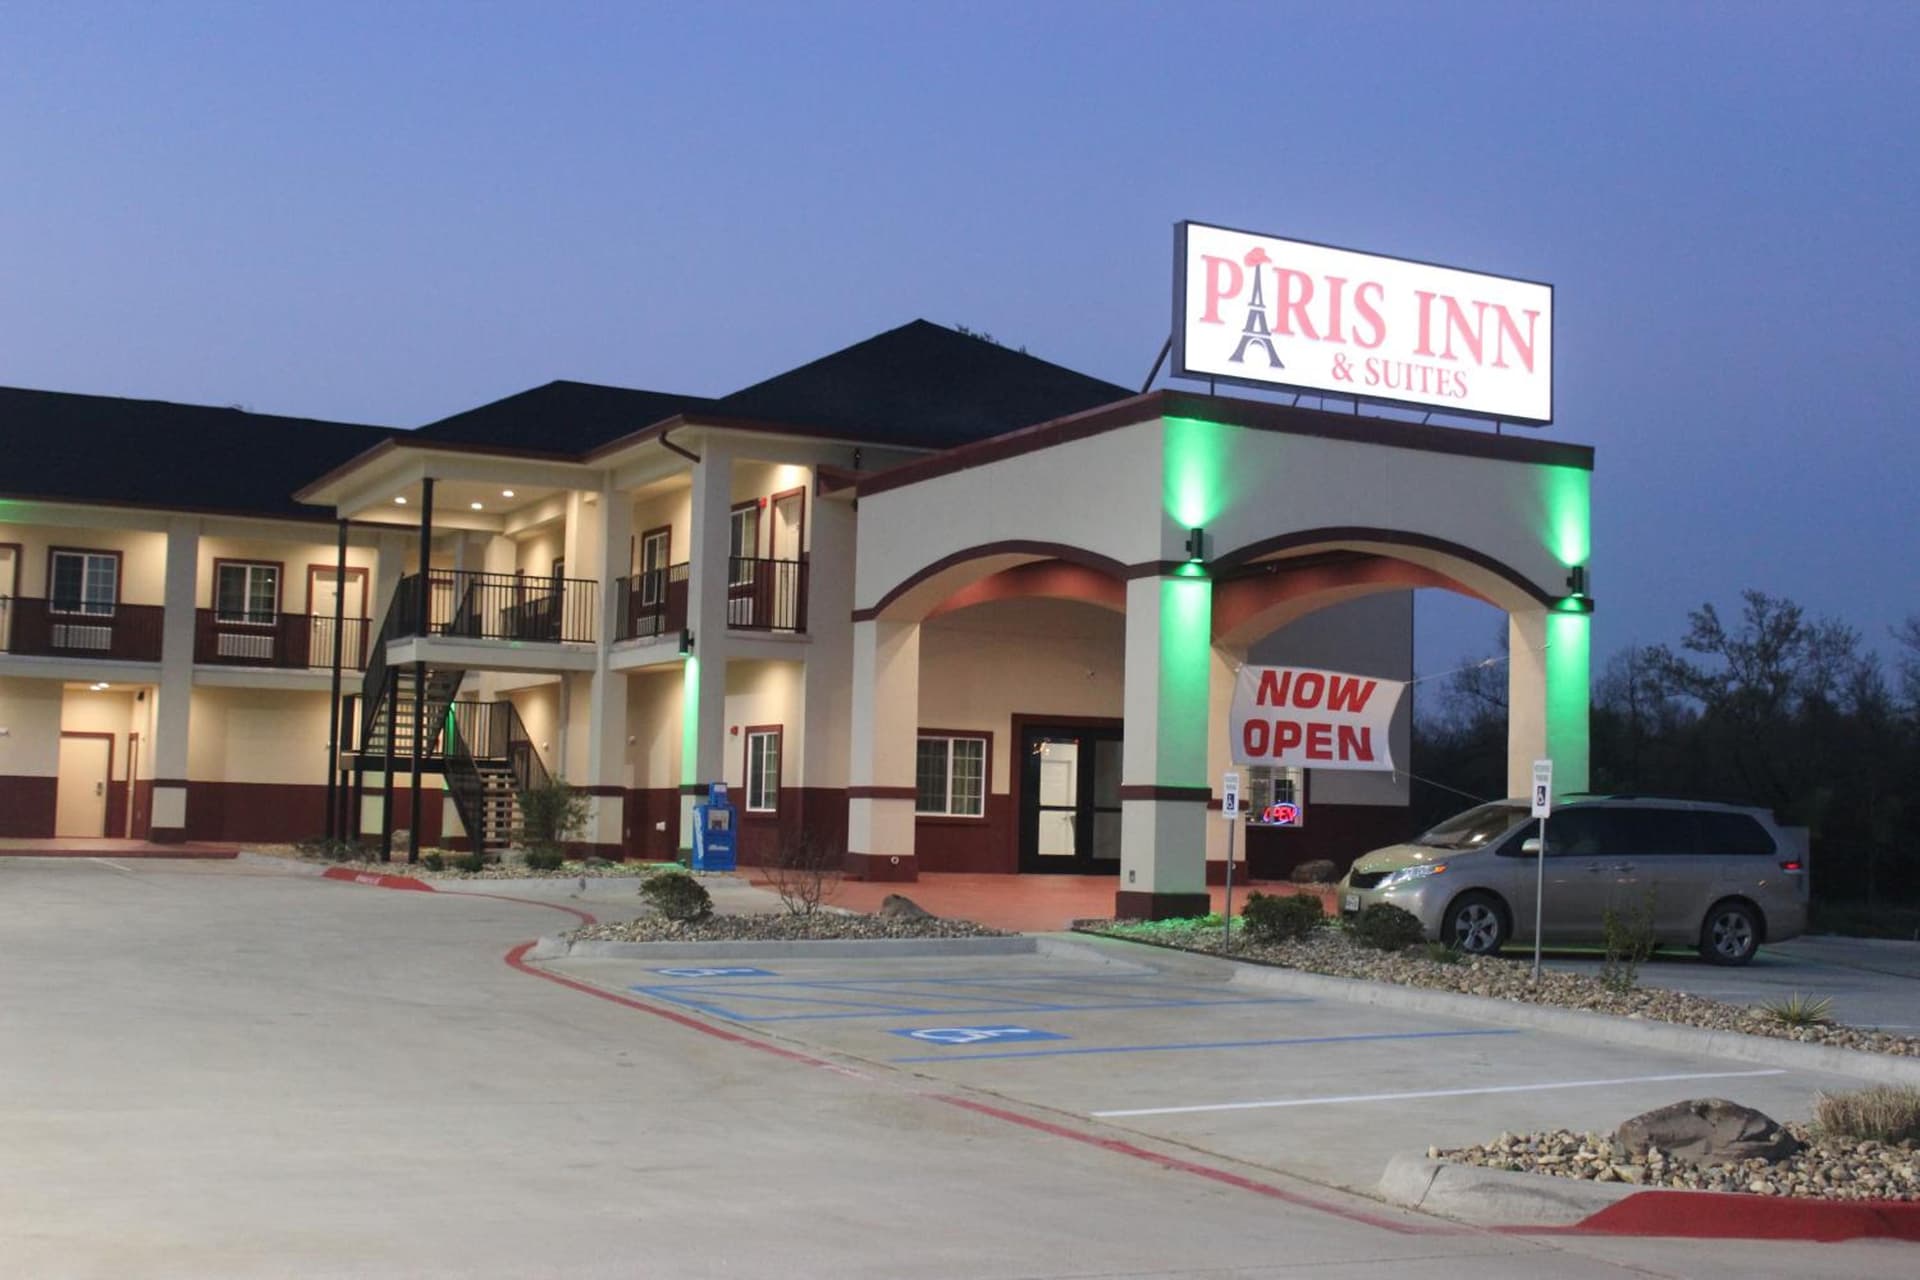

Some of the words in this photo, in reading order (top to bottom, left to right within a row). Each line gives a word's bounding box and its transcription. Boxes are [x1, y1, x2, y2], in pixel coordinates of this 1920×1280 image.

[1199, 247, 1387, 369] PARIS
[1413, 290, 1541, 374] INN
[1331, 352, 1353, 382] &
[1364, 357, 1468, 399] SUITES
[1256, 670, 1377, 713] NOW
[1243, 719, 1374, 762] OPEN
[1263, 806, 1296, 823] OPEN
